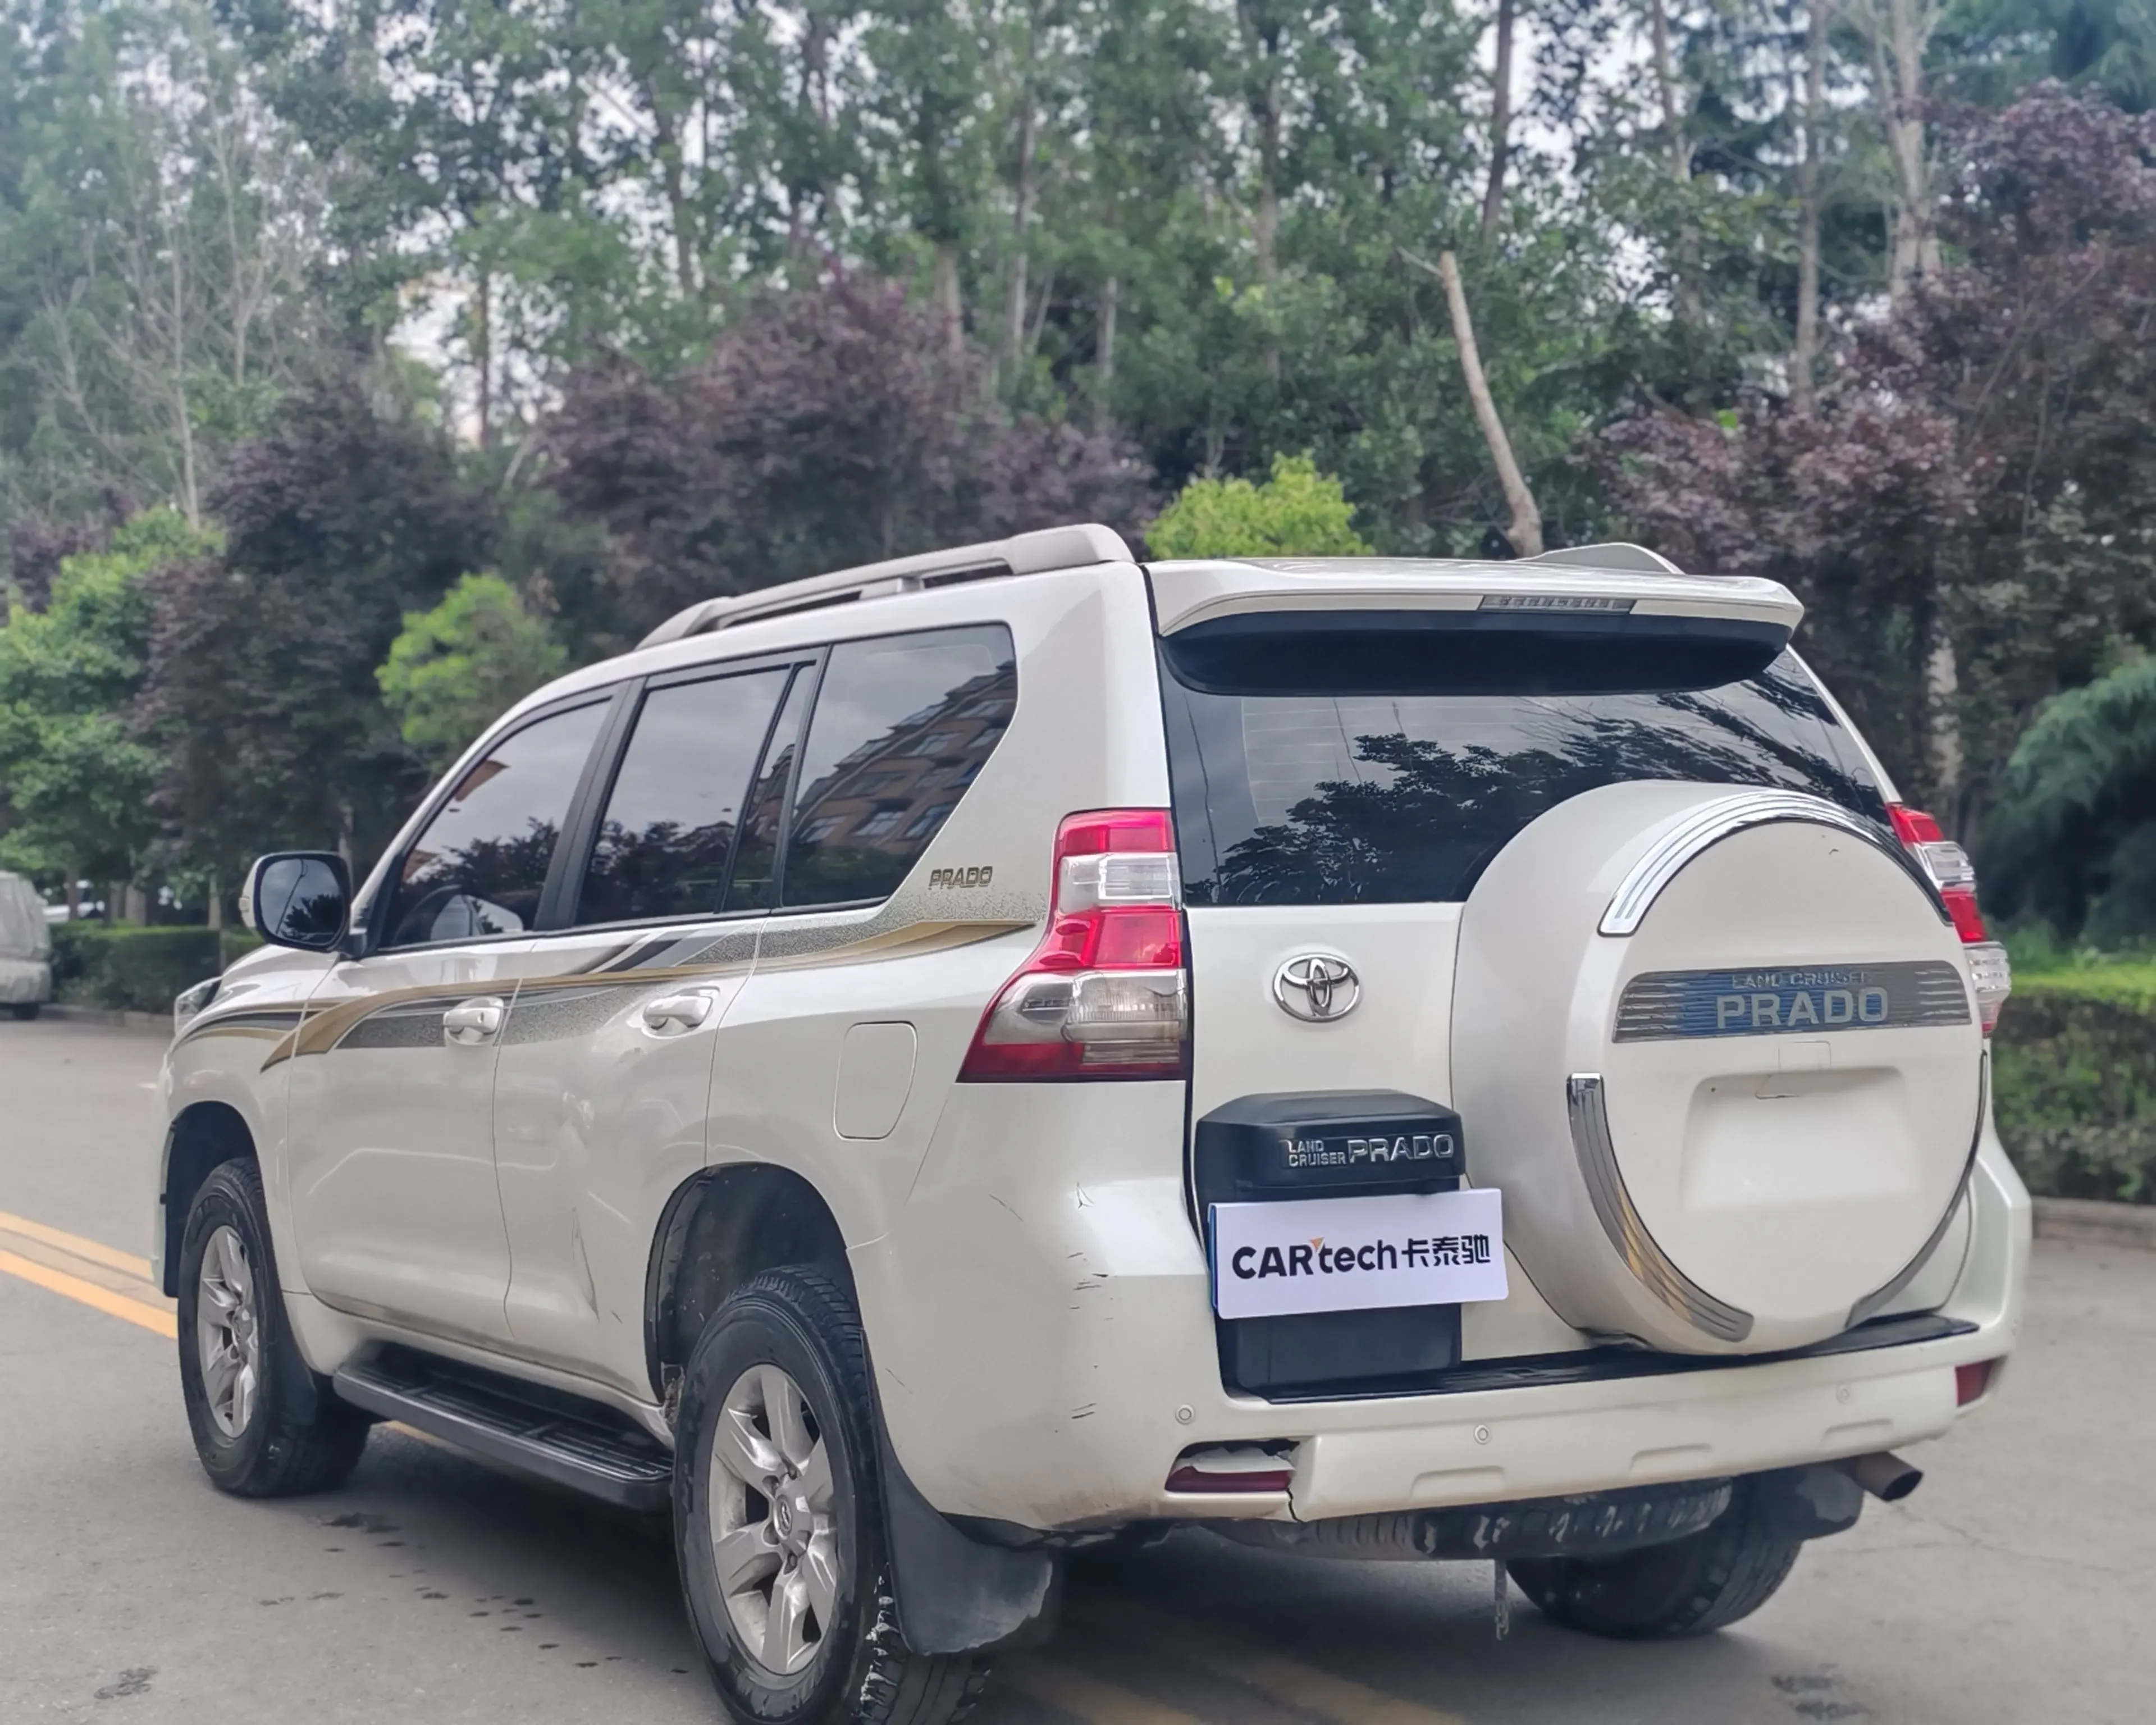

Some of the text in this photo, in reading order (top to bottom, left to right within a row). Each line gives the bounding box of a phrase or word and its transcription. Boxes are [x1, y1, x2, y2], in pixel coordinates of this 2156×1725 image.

[929, 865, 993, 889] PRADO
[1717, 987, 1888, 1029] PRADO
[1283, 1140, 1324, 1153] LAND
[1289, 1152, 1347, 1167] CRUISER
[1347, 1134, 1454, 1163] PRADO
[1401, 1234, 1491, 1268] 卡泰驰
